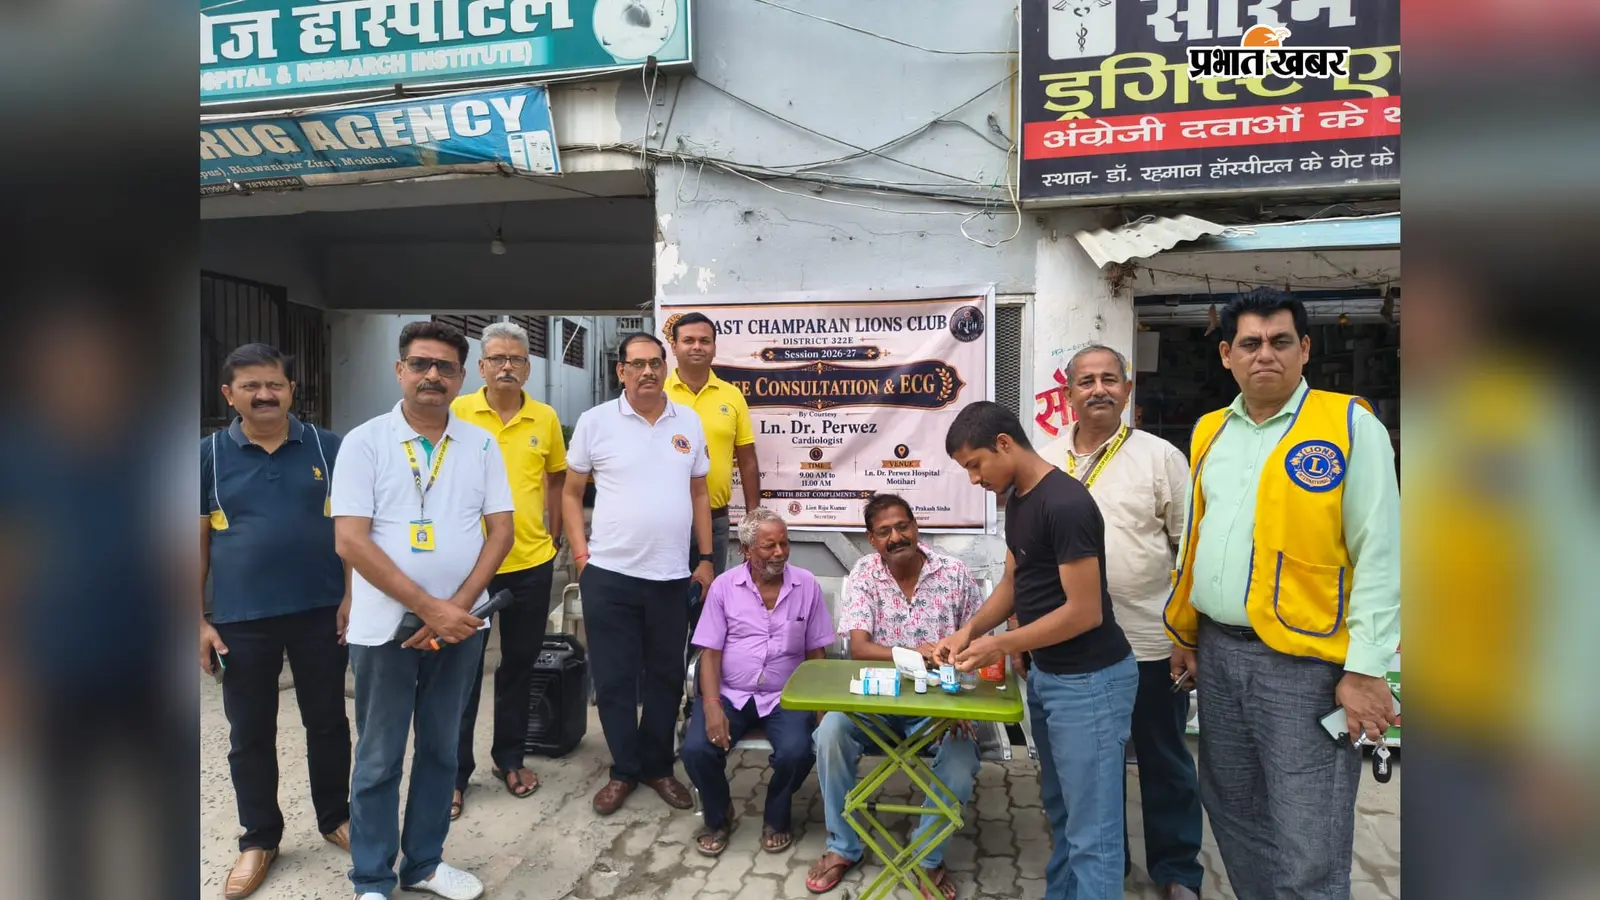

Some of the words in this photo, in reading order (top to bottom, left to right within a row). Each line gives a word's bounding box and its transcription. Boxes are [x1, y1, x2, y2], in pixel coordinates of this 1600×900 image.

[277, 65, 291, 85] &
[299, 95, 528, 151] AGENCY
[1042, 113, 1166, 149] अंग्रेजी
[1180, 103, 1305, 139] दवाओं
[1318, 101, 1368, 129] के
[229, 162, 303, 174] Bhawanipur
[340, 155, 398, 166] Motihari
[1041, 173, 1098, 187] स्थान-
[1106, 164, 1132, 183] डॉ.
[1209, 154, 1292, 179] हॉस्पीटल
[1299, 151, 1323, 171] के
[1330, 148, 1365, 169] गेट
[1370, 146, 1395, 166] के
[714, 319, 743, 335] AST
[747, 317, 850, 334] CHAMPARAN
[855, 317, 902, 333] LIONS
[906, 315, 947, 331] CLUB
[783, 337, 828, 345] DISTRICT
[831, 336, 854, 344] 322E
[784, 350, 819, 359] Session
[821, 349, 857, 358] 2026-27
[883, 376, 895, 394] &
[899, 374, 936, 395] ECG
[760, 420, 786, 434] Ln.
[791, 420, 815, 434] Dr.
[822, 420, 877, 434] Perwez
[792, 436, 843, 445] Cardiologist
[1303, 446, 1335, 459] LIONS
[889, 460, 914, 468] VENUE
[1308, 457, 1324, 474] L
[912, 470, 940, 478] Hospital
